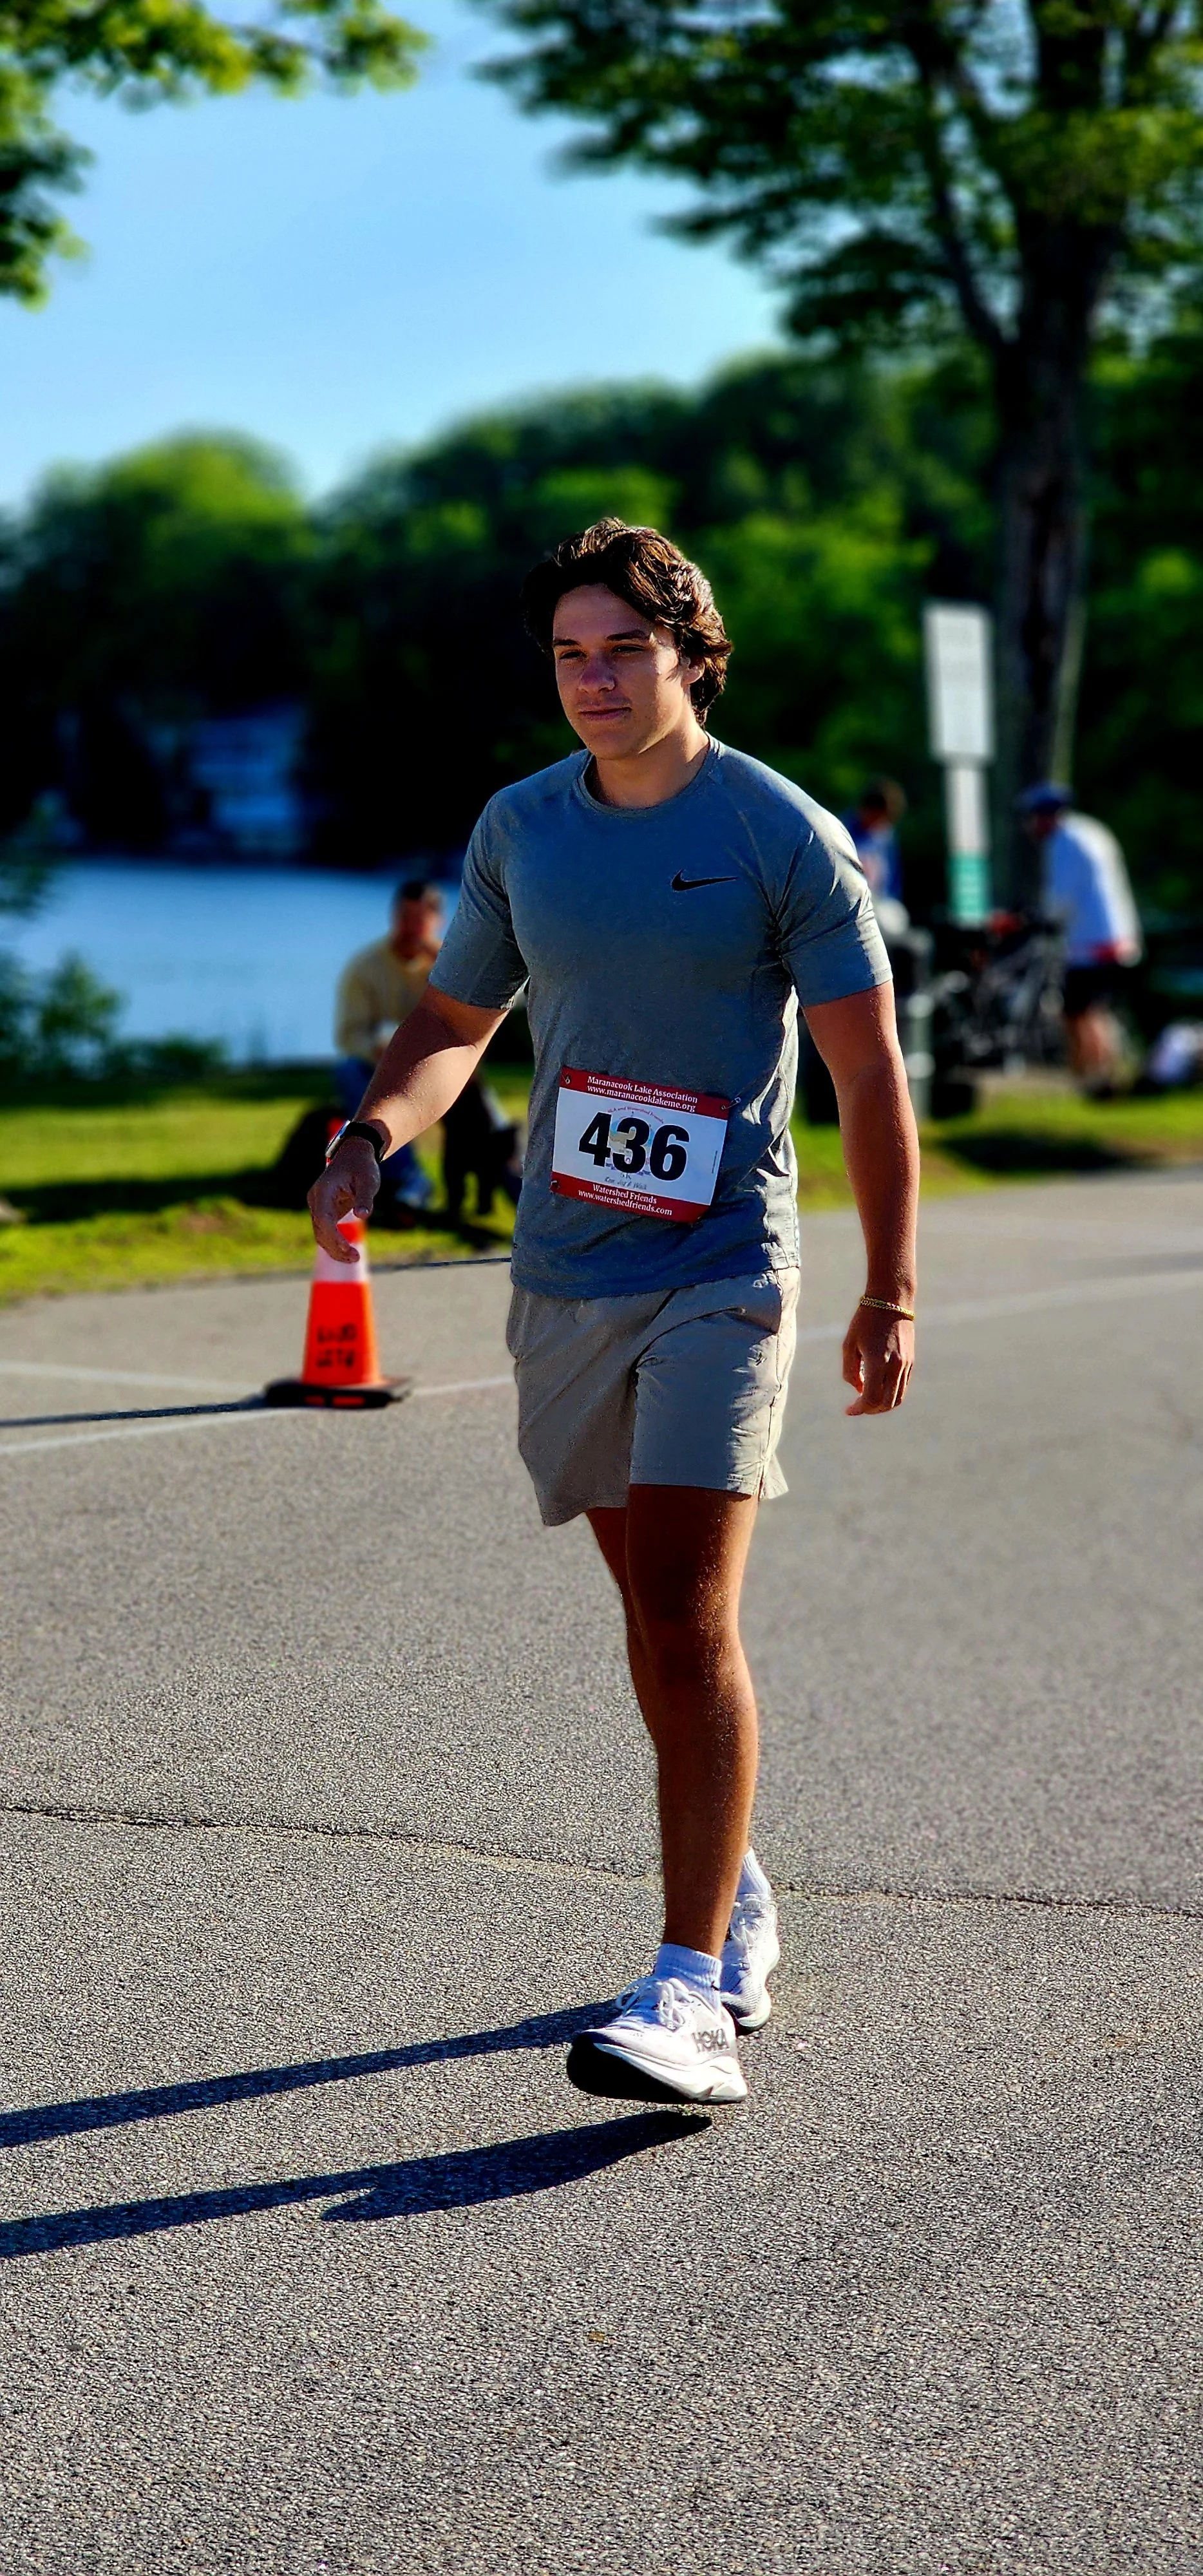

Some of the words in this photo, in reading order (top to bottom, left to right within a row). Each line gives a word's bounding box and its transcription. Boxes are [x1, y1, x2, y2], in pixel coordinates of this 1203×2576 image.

[587, 1075, 633, 1091] Maranacook
[634, 1084, 652, 1095] Lake
[652, 1088, 697, 1104] Association
[587, 1085, 696, 1112] www.maranacooklakeme.org
[578, 1112, 690, 1181] 436
[578, 1189, 672, 1216] www.watershedfriends.com
[592, 1184, 629, 1198] Watershed
[630, 1191, 657, 1204] Friends
[692, 2028, 730, 2053] HOKA
